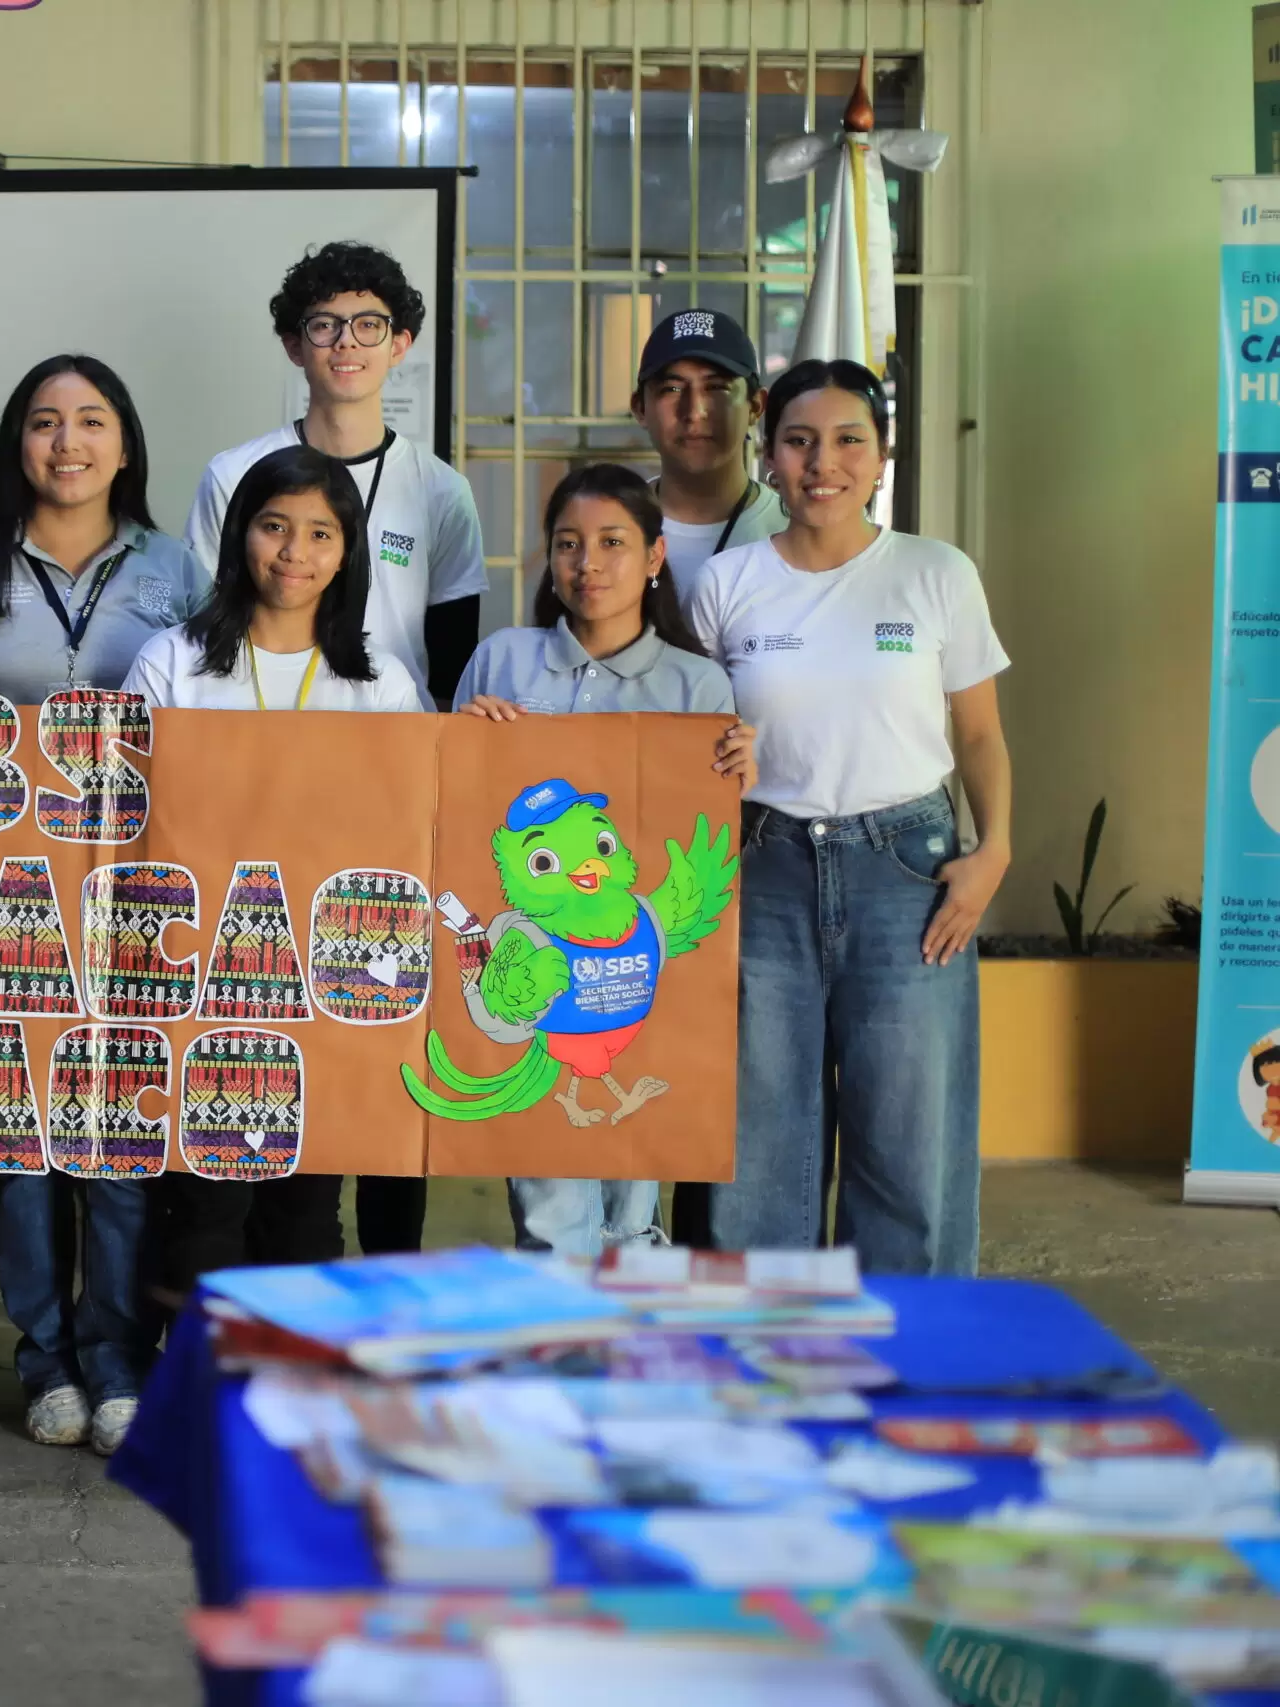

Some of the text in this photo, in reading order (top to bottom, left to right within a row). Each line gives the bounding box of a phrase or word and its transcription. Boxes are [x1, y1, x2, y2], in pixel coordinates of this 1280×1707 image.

[675, 311, 714, 320] SERVICIO
[675, 317, 714, 326] CIVICO
[673, 328, 714, 340] 2026
[381, 536, 413, 551] CIVICO
[380, 549, 409, 567] 2026
[875, 628, 914, 636] CIVICO
[1231, 628, 1280, 640] respeto
[875, 640, 913, 652] 2026
[1219, 940, 1235, 951] de
[605, 953, 649, 977] SBS
[632, 981, 645, 990] DE
[621, 989, 650, 999] SOCIAL
